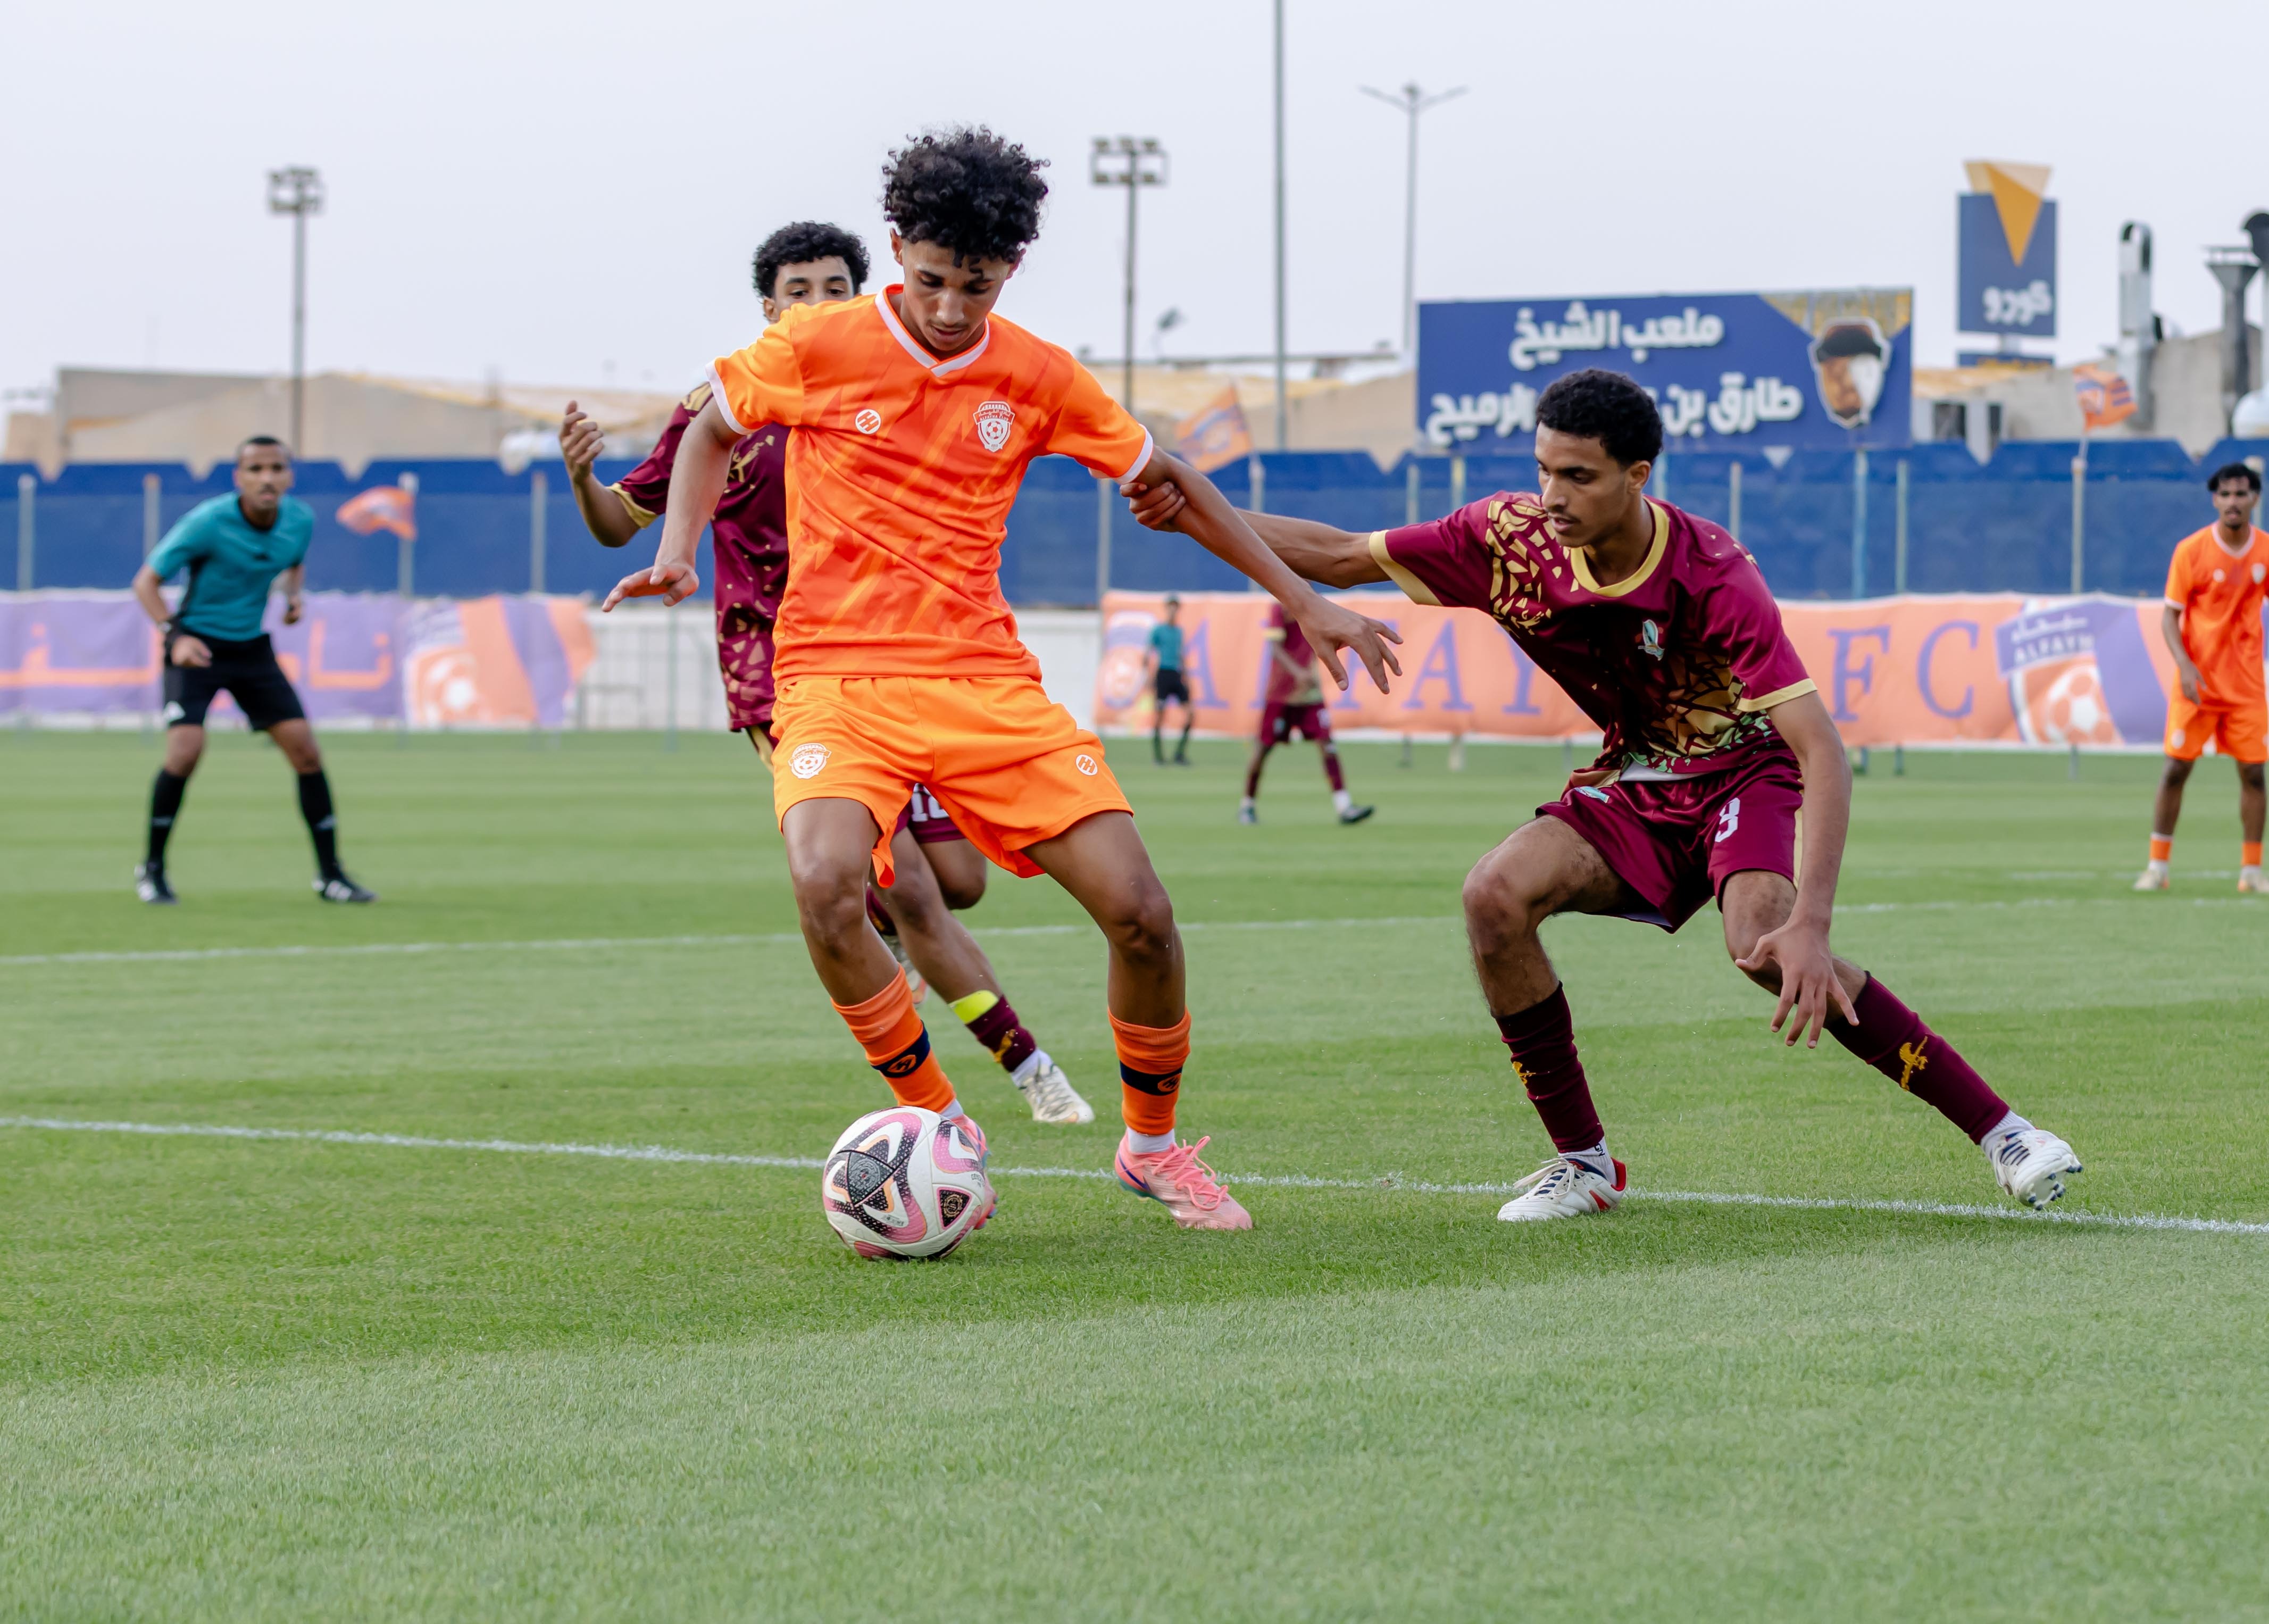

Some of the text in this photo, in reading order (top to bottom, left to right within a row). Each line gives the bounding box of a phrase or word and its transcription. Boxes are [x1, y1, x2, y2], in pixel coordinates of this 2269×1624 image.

[1509, 300, 1724, 370] ملعب الشيخ
[1661, 384, 1707, 438] بن
[1707, 372, 1804, 435] طارق
